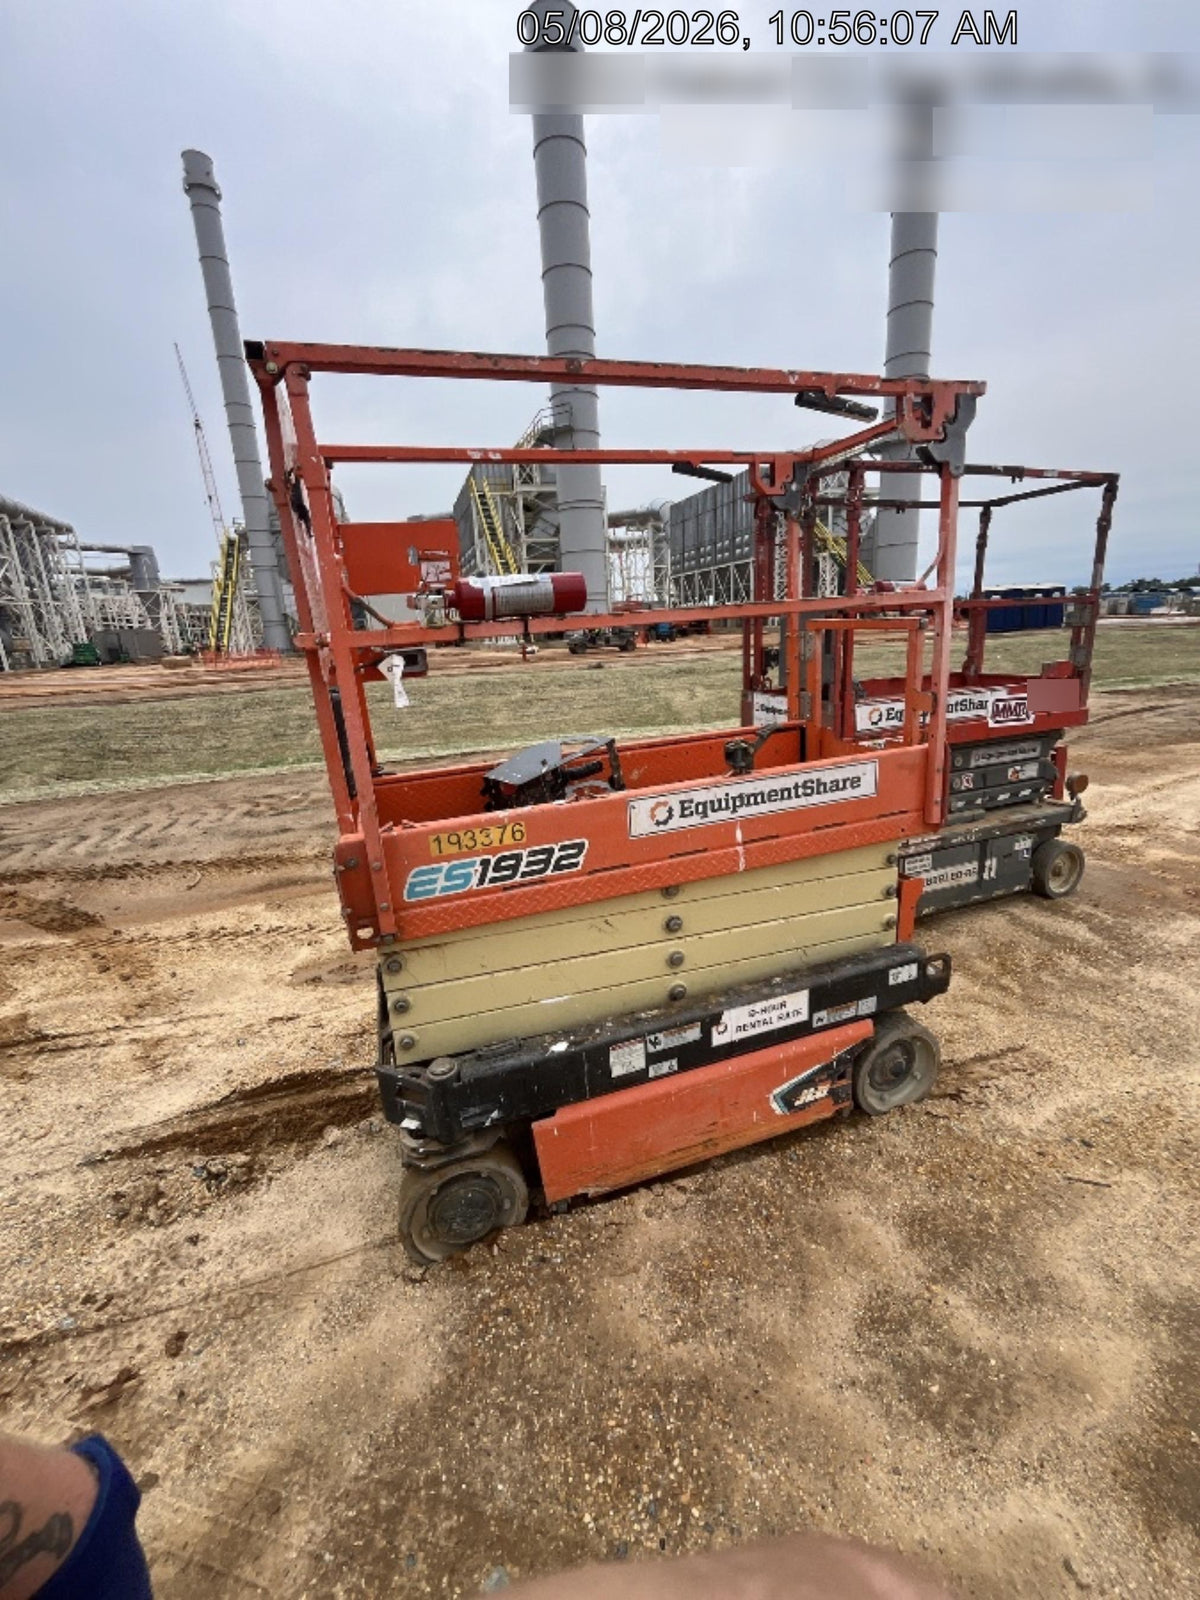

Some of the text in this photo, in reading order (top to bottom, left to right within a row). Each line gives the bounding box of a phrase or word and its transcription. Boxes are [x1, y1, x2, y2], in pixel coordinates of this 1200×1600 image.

[678, 773, 862, 820] EquipmentShare
[431, 822, 525, 855] 193376
[404, 839, 588, 902] ES1932
